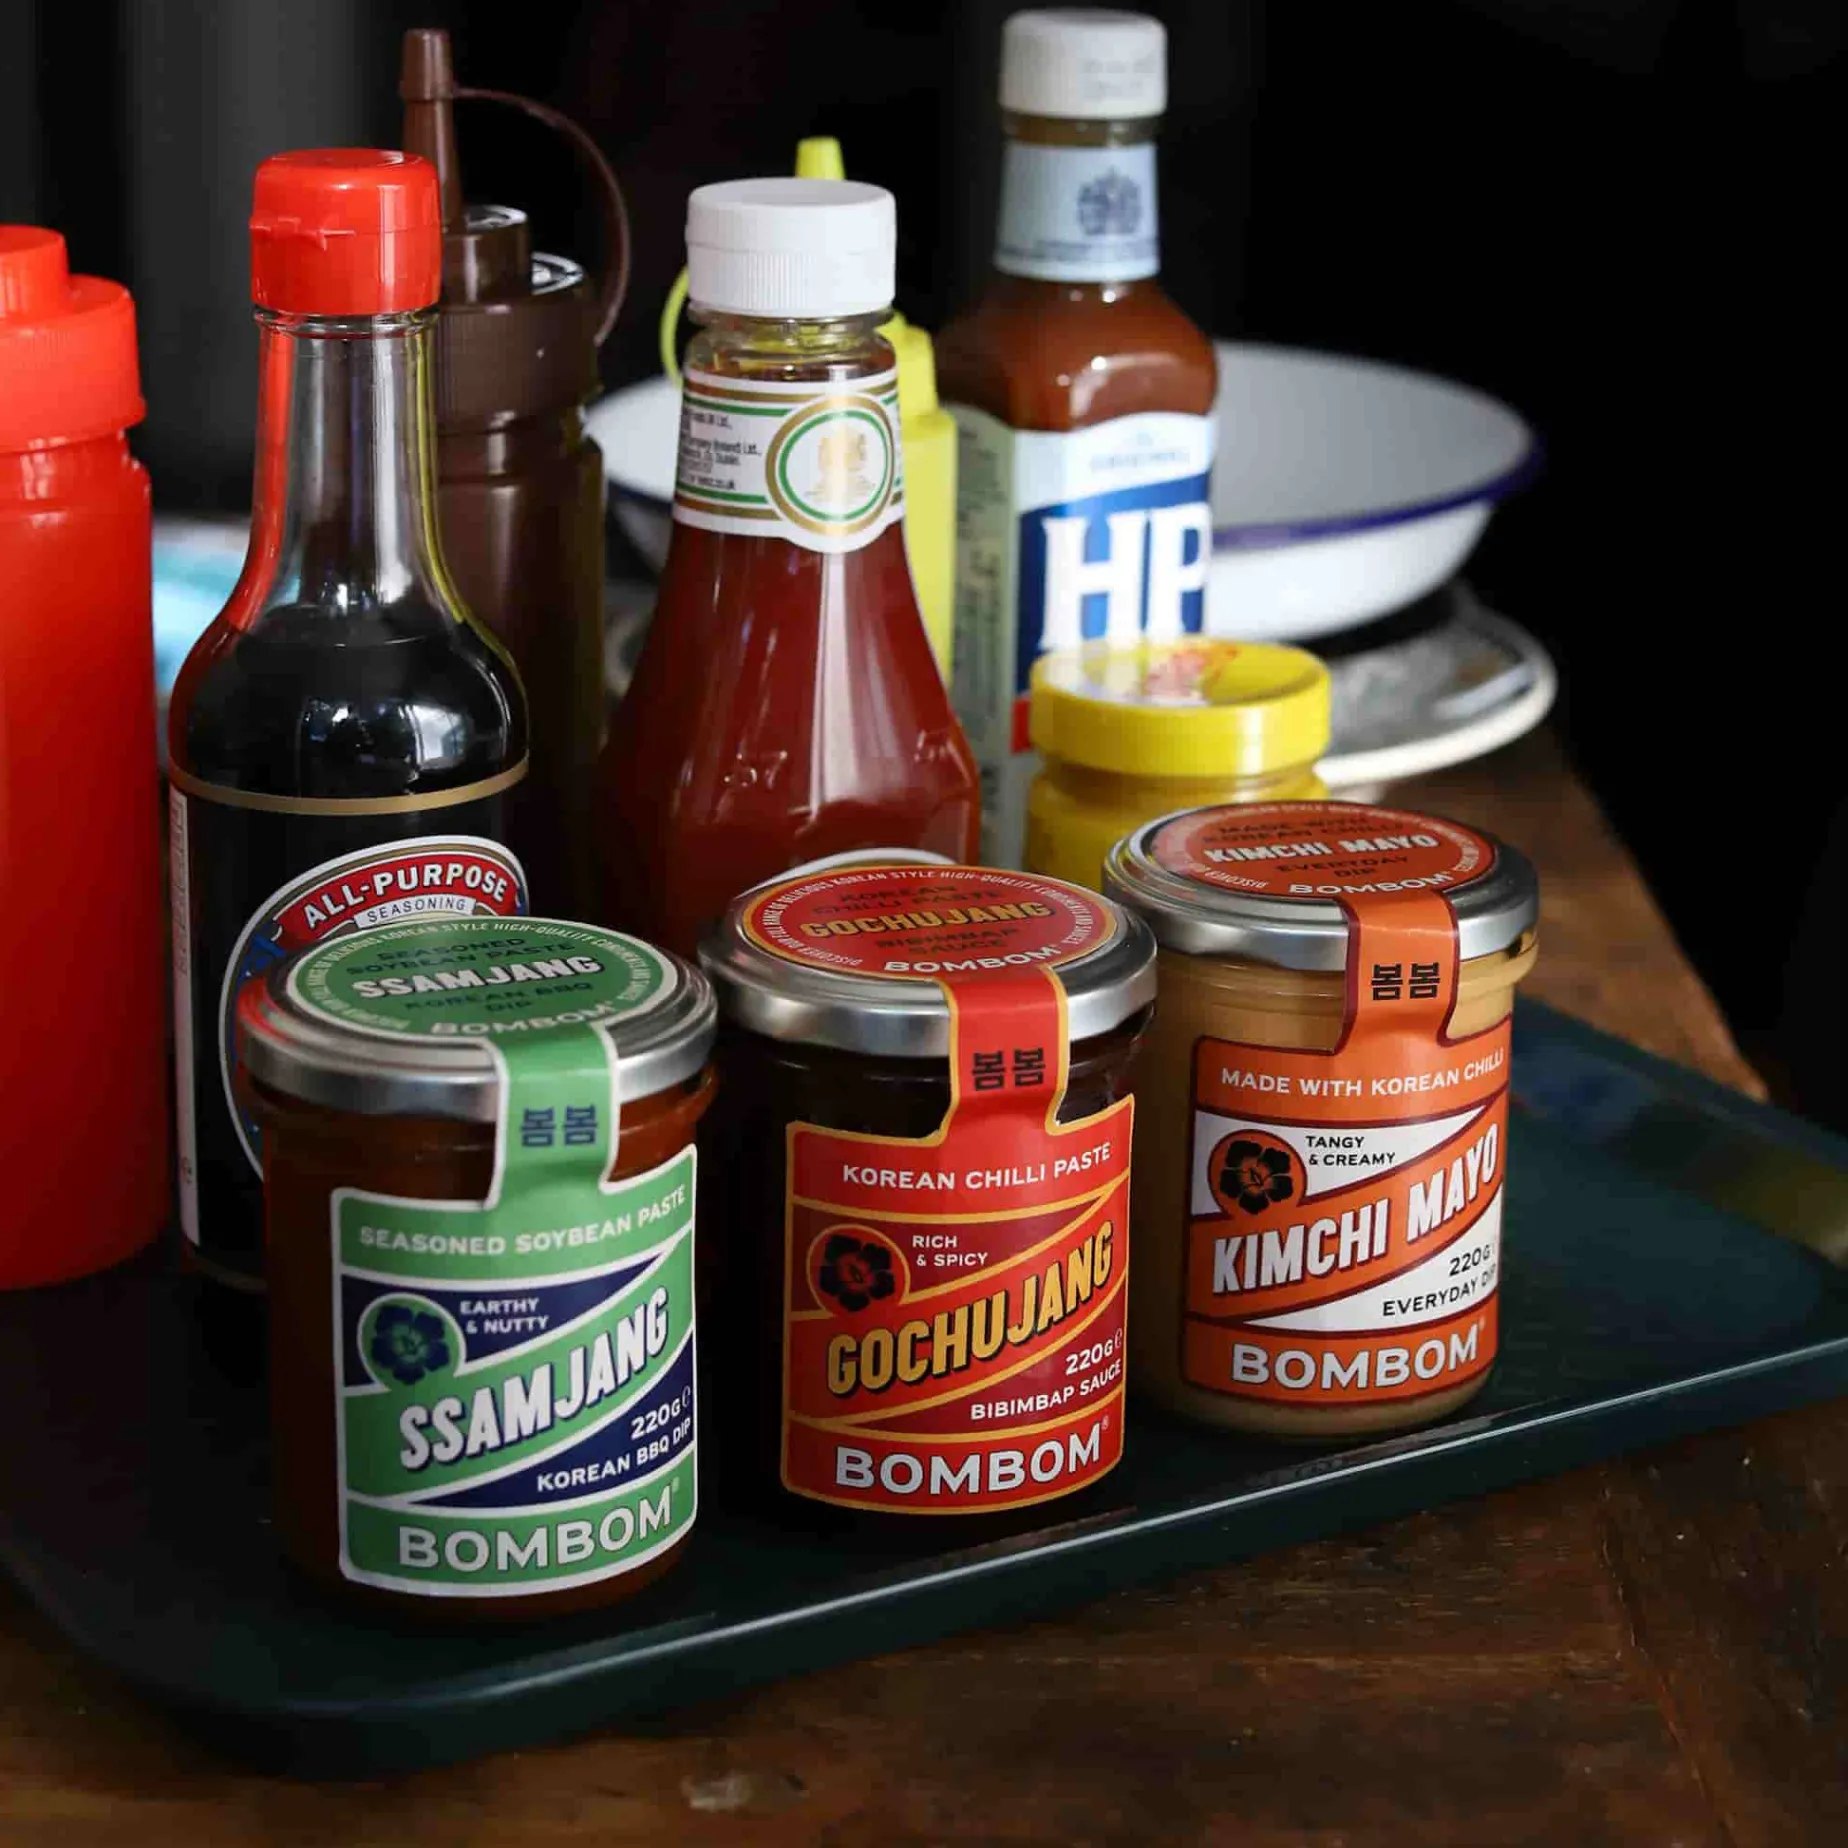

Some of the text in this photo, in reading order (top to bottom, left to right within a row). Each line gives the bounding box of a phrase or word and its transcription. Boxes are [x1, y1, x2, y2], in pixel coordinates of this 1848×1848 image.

[1038, 500, 1213, 650] HP
[1203, 841, 1333, 863] KIMCHI
[1338, 834, 1439, 853] MAYO
[1275, 855, 1408, 872] EVERYDAY
[890, 870, 937, 879] STYLE
[1334, 867, 1376, 878] DIP
[303, 862, 509, 929] ALL-PURPOSE
[367, 897, 467, 924] SEASONING
[799, 901, 1055, 938] GOCHUJANG
[347, 942, 575, 975] SOYBEAN PASTE
[377, 938, 525, 961] SEASONED
[353, 956, 604, 998] SSAMJANG
[1371, 961, 1441, 1001] 봄봄
[972, 1047, 1046, 1092] 봄봄
[1221, 1047, 1505, 1097] MADE WITH KOREAN CHILLI
[520, 1104, 598, 1147] 봄봄
[1305, 1134, 1365, 1149] TANGY
[842, 1141, 1113, 1191] KOREAN CHILLI PASTE
[1308, 1151, 1396, 1167] & CREAMY
[360, 1184, 687, 1255] SEASONED SOYBEAN PASTE
[1213, 1122, 1499, 1295] KIMCHI MAYO
[912, 1234, 958, 1249] RICH
[916, 1251, 988, 1267] & SPICY
[459, 1297, 540, 1316] EARTHY
[827, 1219, 1114, 1396] GOCHUJANG
[1382, 1281, 1479, 1317] EVERYDAY
[465, 1315, 550, 1334] & NUTTY
[1065, 1338, 1114, 1377] 220G
[1231, 1323, 1479, 1391] BOMBOM
[399, 1285, 668, 1472] SSAMJANG
[970, 1358, 1122, 1421] BIBIMBAP SAUCE
[630, 1398, 681, 1441] 220G
[537, 1416, 692, 1492] KOREAN BBQ DIP
[834, 1421, 1102, 1496] BOMBOM
[398, 1486, 672, 1572] BOMBOM
